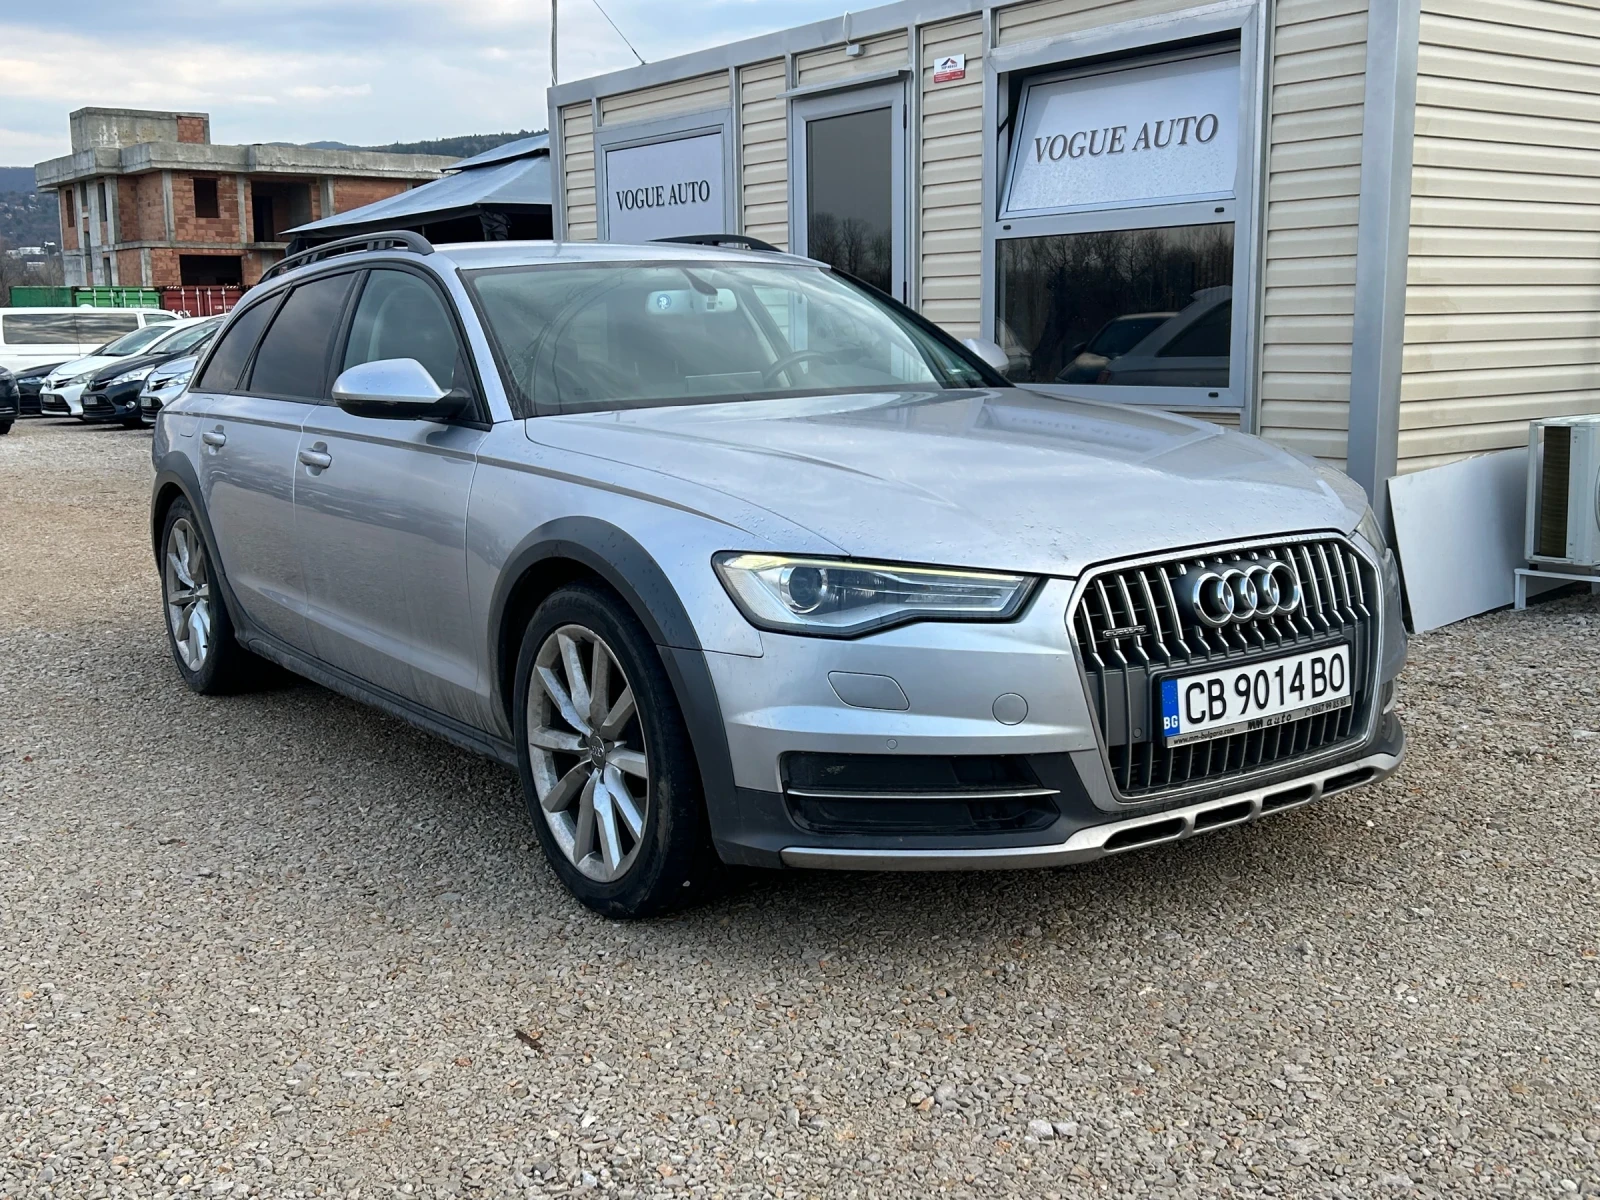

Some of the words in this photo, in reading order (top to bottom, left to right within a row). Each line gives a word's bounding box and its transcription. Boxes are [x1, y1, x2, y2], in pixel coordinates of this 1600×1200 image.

[1034, 125, 1127, 164] VOGUE
[1132, 113, 1219, 151] AUTO
[616, 185, 665, 211] VOGUE
[668, 179, 711, 206] AUTO
[1185, 678, 1227, 724] CB
[1234, 661, 1305, 715] 9014
[1311, 653, 1345, 699] BO
[1164, 715, 1178, 730] BG
[1266, 713, 1292, 727] auto
